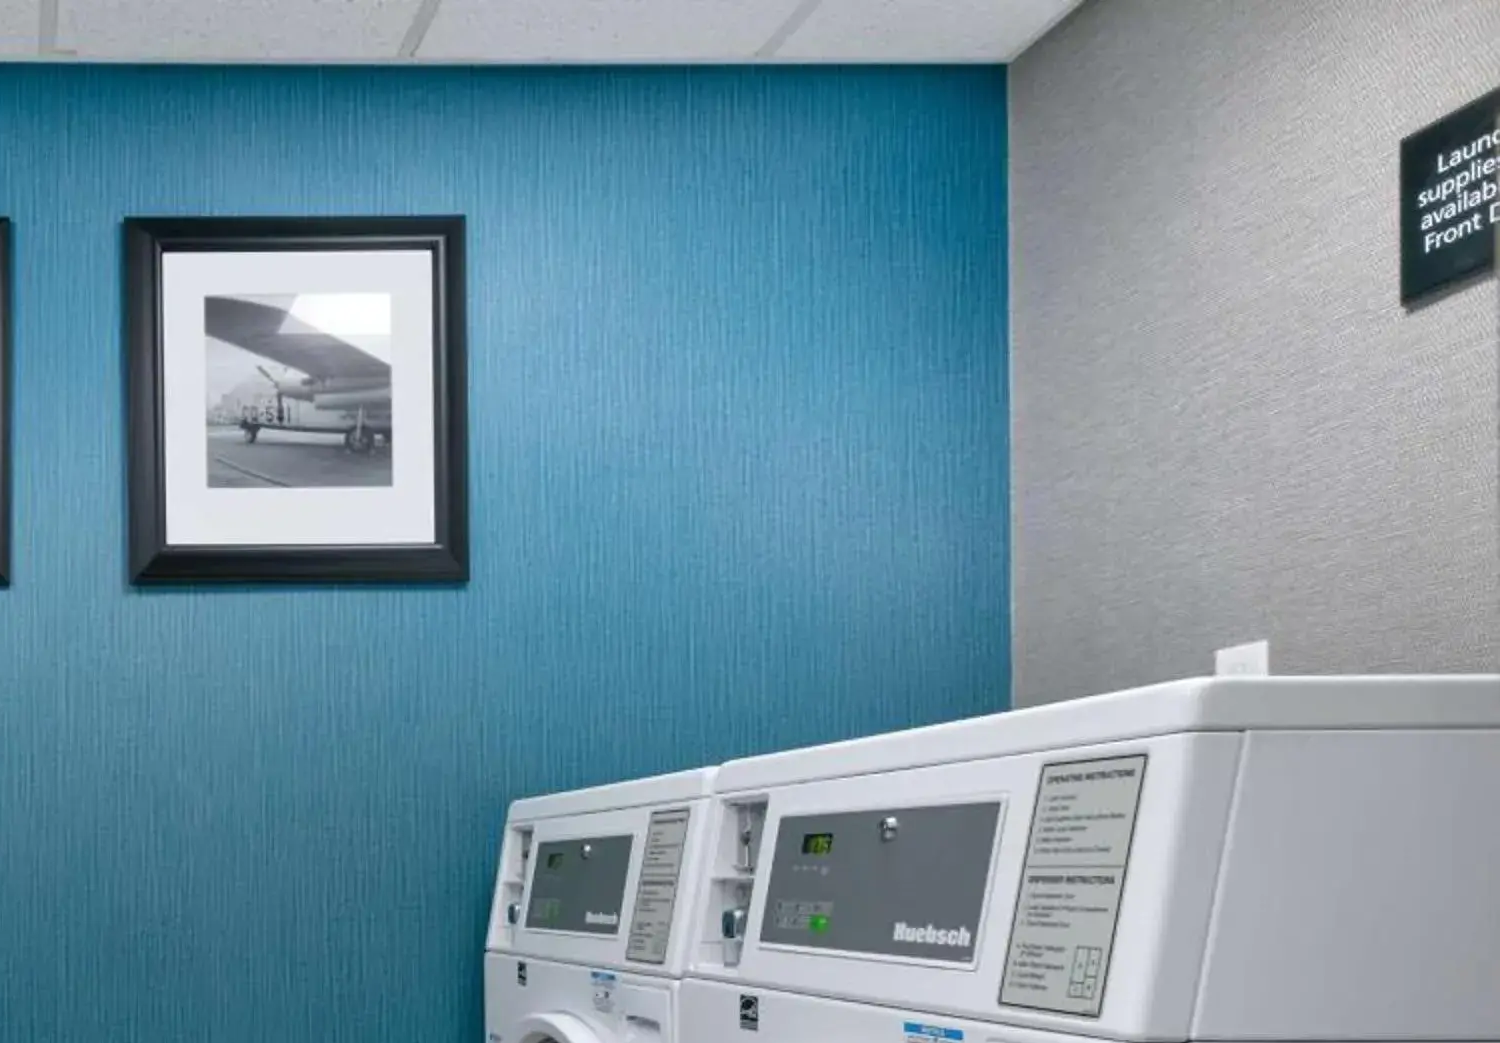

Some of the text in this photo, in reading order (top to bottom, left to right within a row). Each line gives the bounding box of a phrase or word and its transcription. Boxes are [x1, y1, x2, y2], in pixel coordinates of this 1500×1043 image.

[1420, 180, 1500, 231] availab
[1424, 213, 1483, 254] Front
[893, 920, 971, 948] Huebsch
